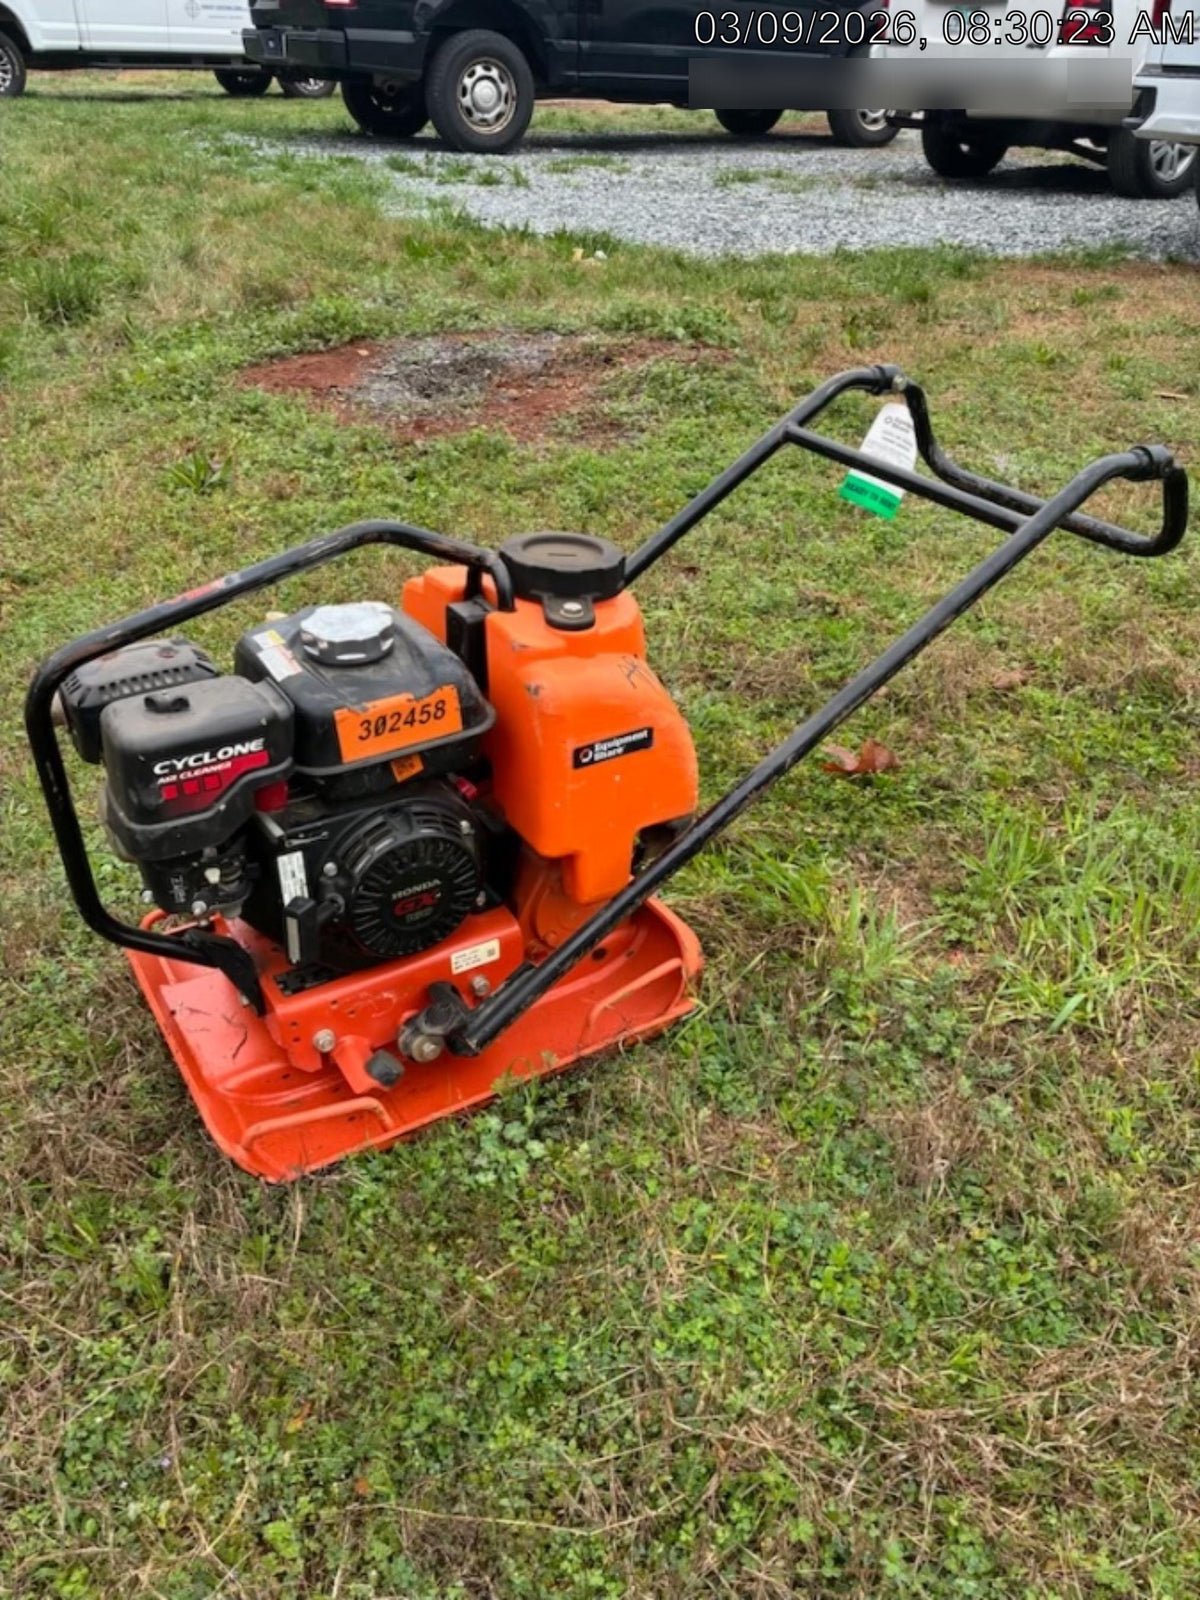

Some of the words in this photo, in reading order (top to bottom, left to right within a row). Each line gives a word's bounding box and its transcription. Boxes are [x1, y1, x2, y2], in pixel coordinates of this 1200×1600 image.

[358, 699, 447, 741] 302458
[594, 729, 649, 752] Equipment
[153, 737, 266, 775] CYCLONE
[593, 746, 626, 761] Share
[157, 774, 178, 785] AIR
[179, 760, 232, 780] CLEANER
[391, 878, 442, 901] HONDA
